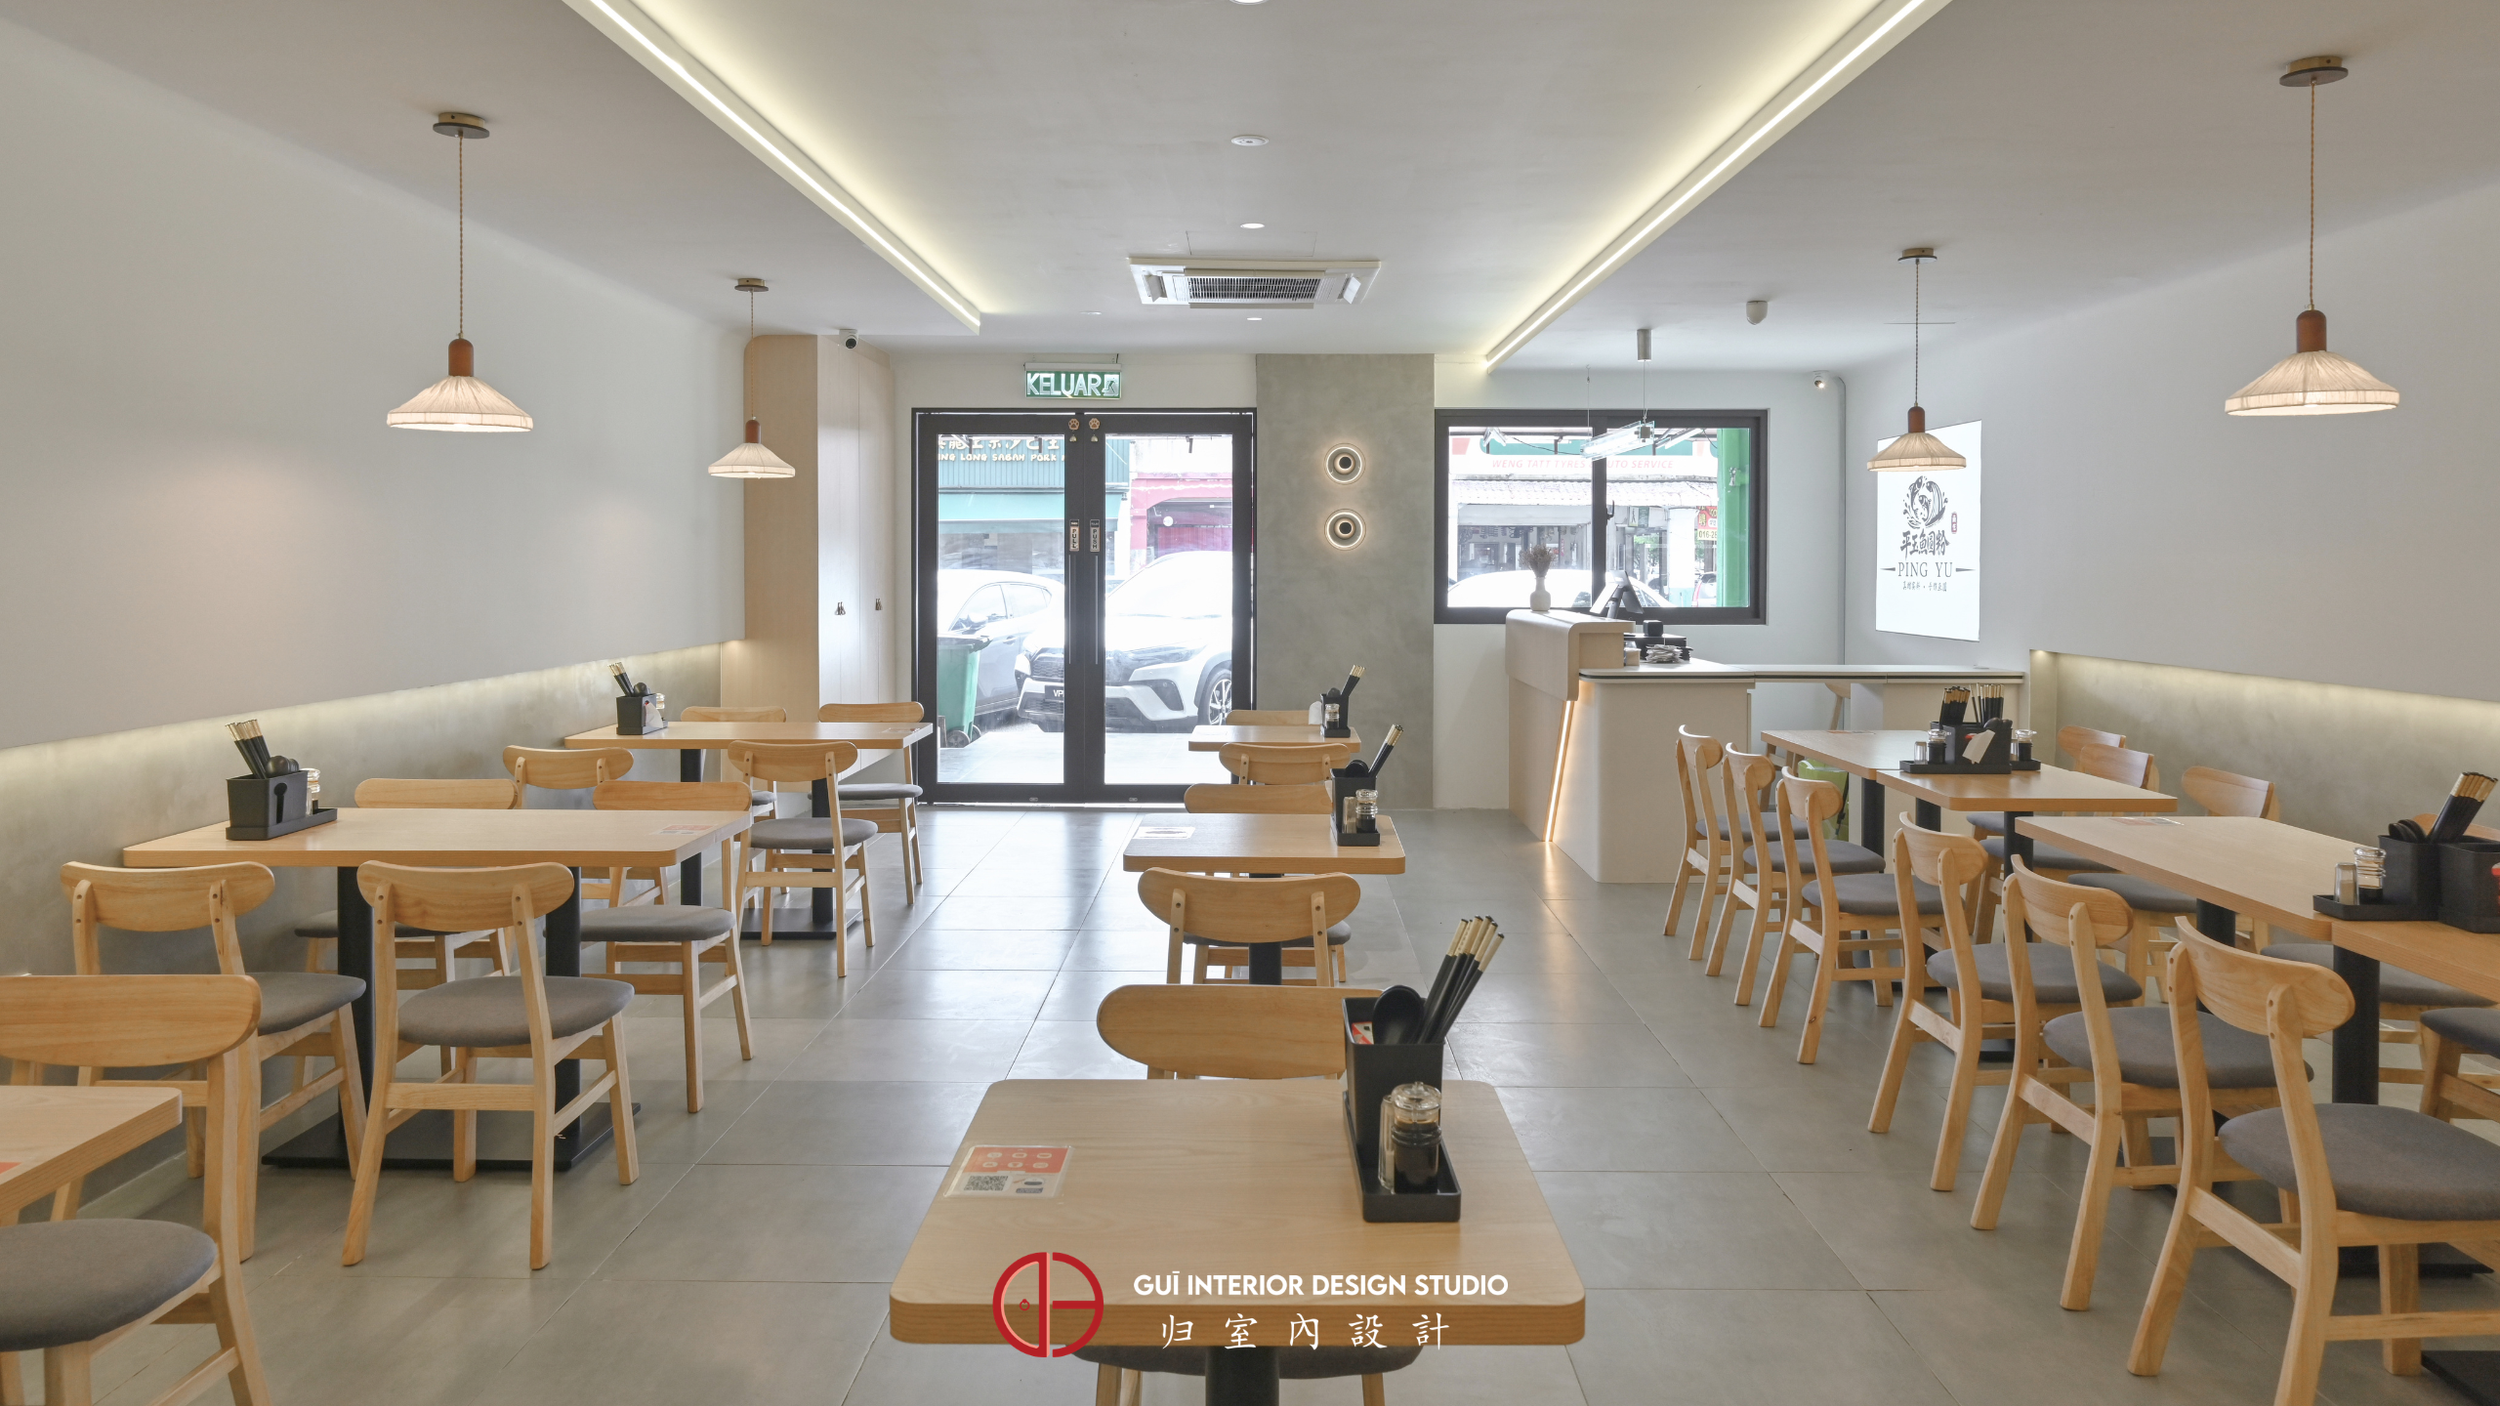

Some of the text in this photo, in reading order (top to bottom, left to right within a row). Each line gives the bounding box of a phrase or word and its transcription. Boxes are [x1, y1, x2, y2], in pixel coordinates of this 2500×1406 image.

[1027, 373, 1101, 396] KELUAR
[960, 453, 988, 462] LONG
[992, 453, 1026, 462] SABAH
[1030, 453, 1057, 462] PORK
[1492, 460, 1523, 469] WENG
[1527, 460, 1551, 469] TATT
[1554, 460, 1586, 469] TYRES
[1607, 460, 1628, 469] UTO
[1631, 460, 1674, 469] SERVICE
[1898, 561, 1953, 578] PING YU
